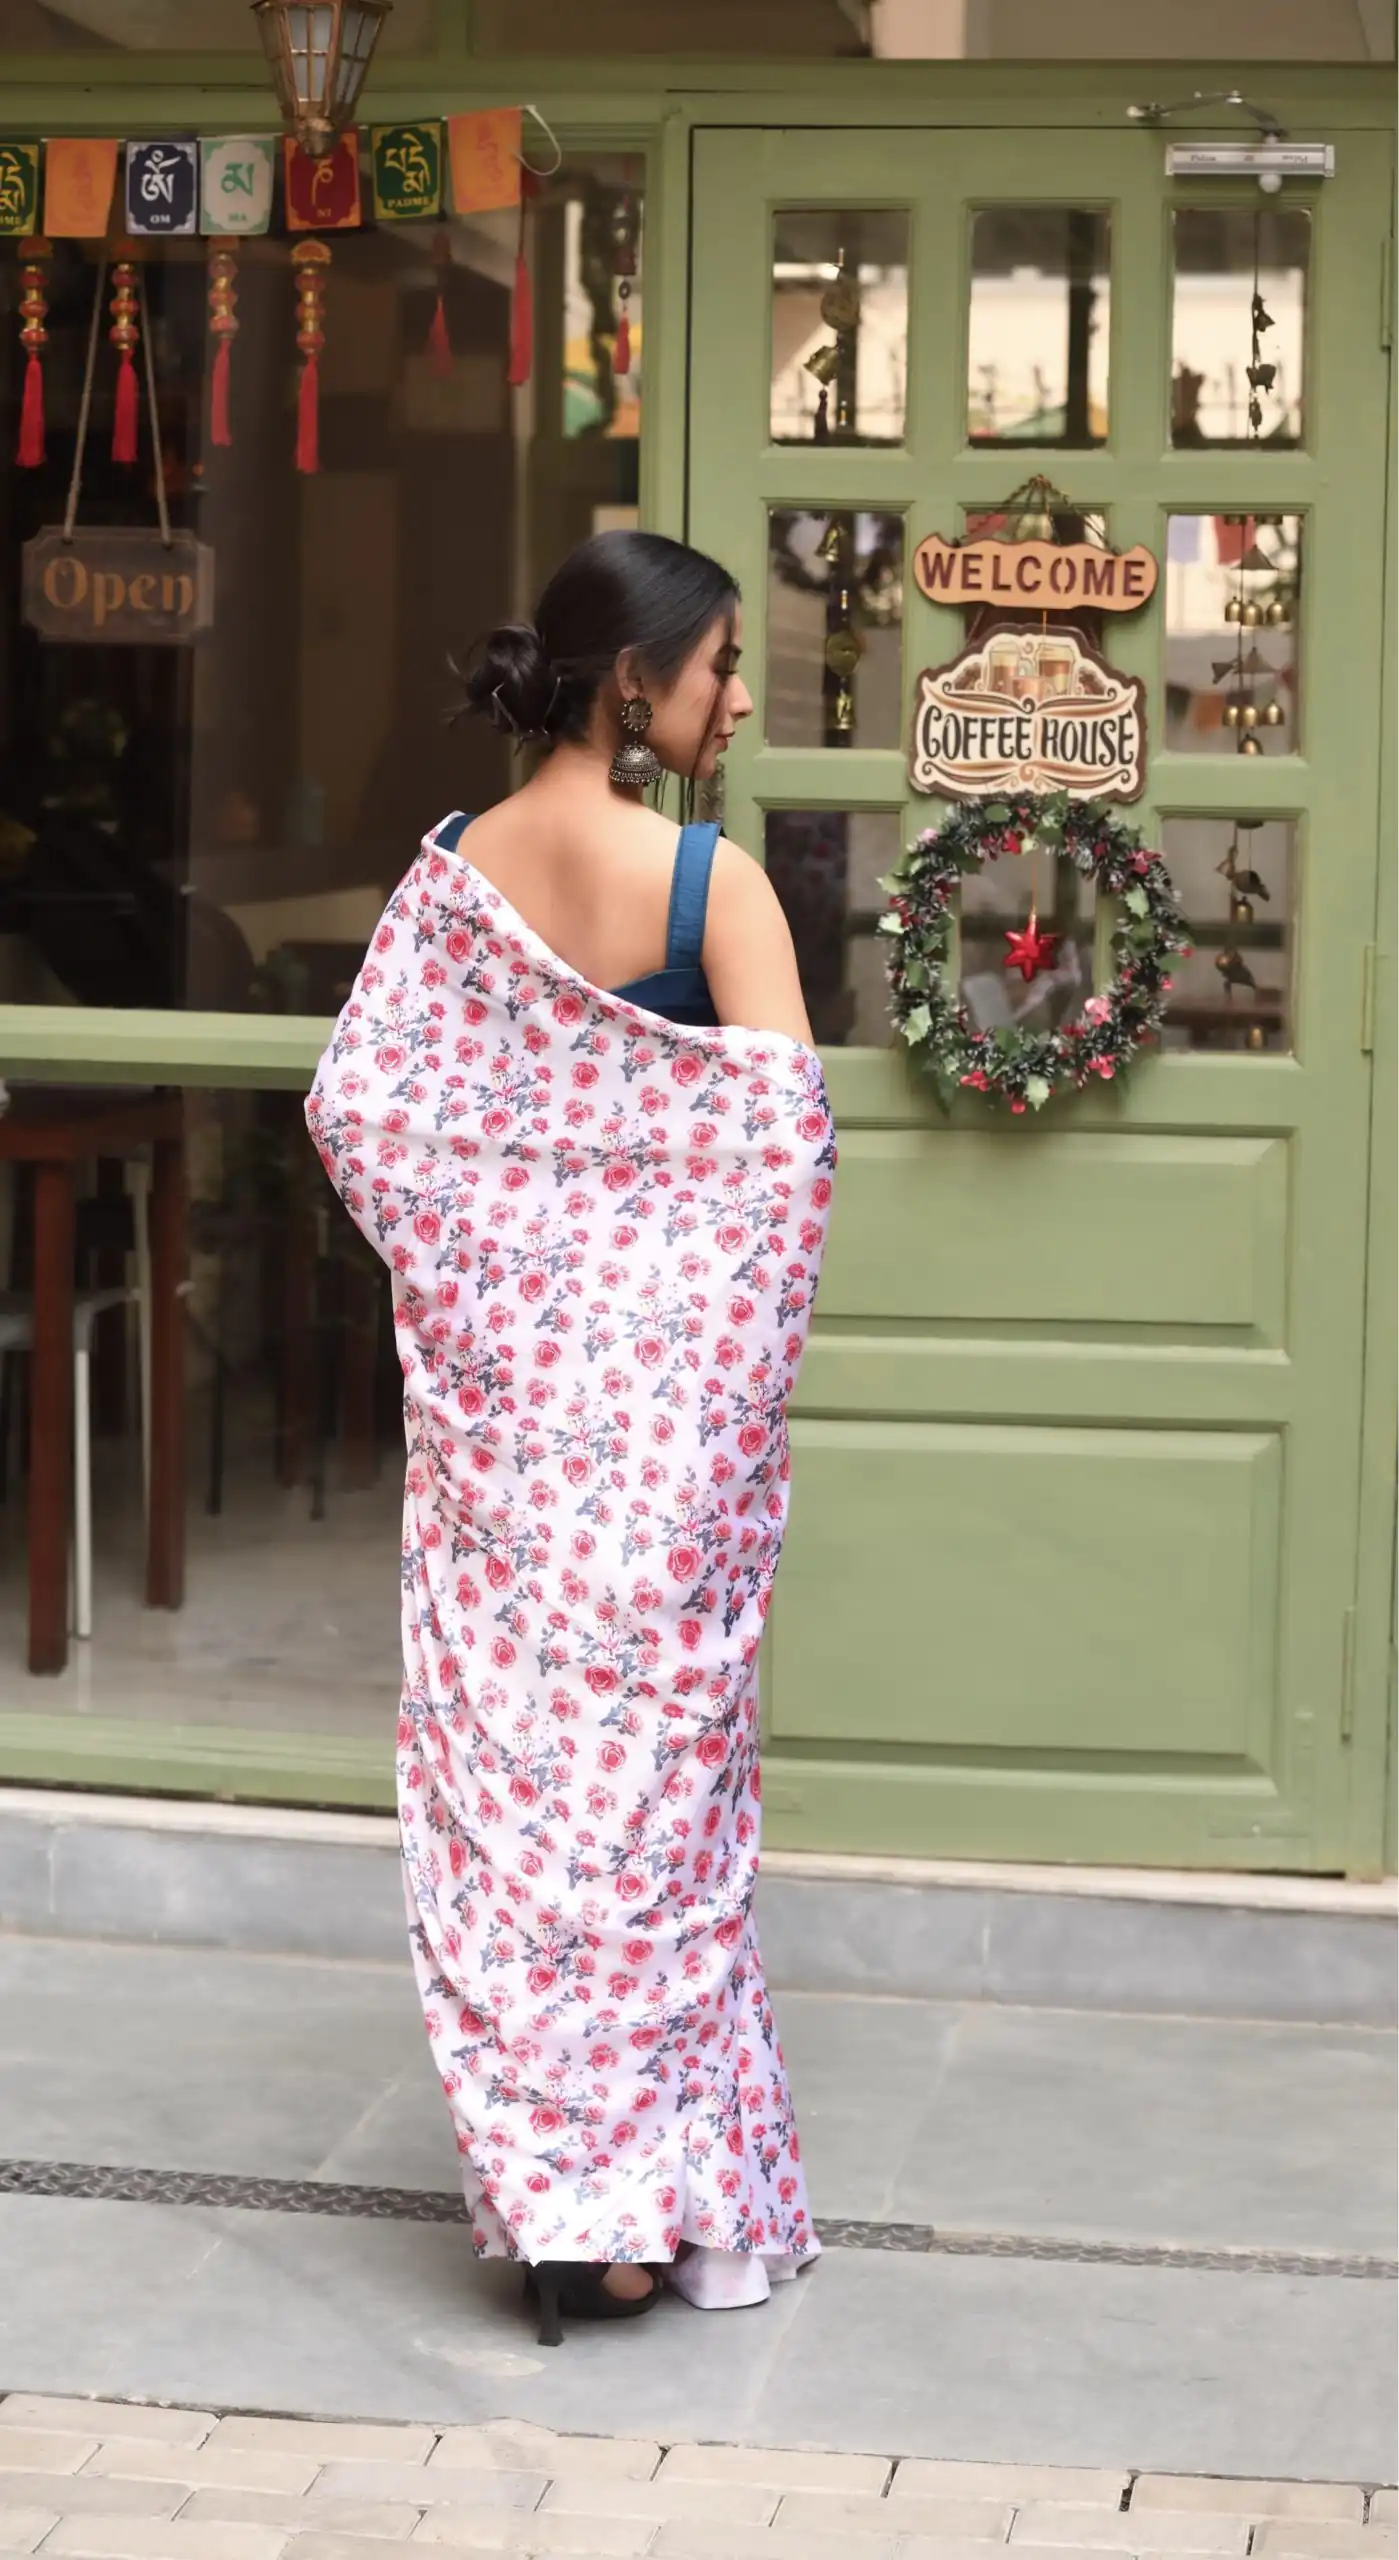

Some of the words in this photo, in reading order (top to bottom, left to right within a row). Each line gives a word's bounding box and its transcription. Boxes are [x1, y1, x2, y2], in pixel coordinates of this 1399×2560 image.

[149, 213, 172, 225] OM
[387, 197, 431, 209] PADME
[43, 556, 194, 628] Open
[921, 552, 1146, 598] WELCOME
[922, 704, 1033, 760] COFFEE
[1041, 709, 1135, 767] HOUSE
